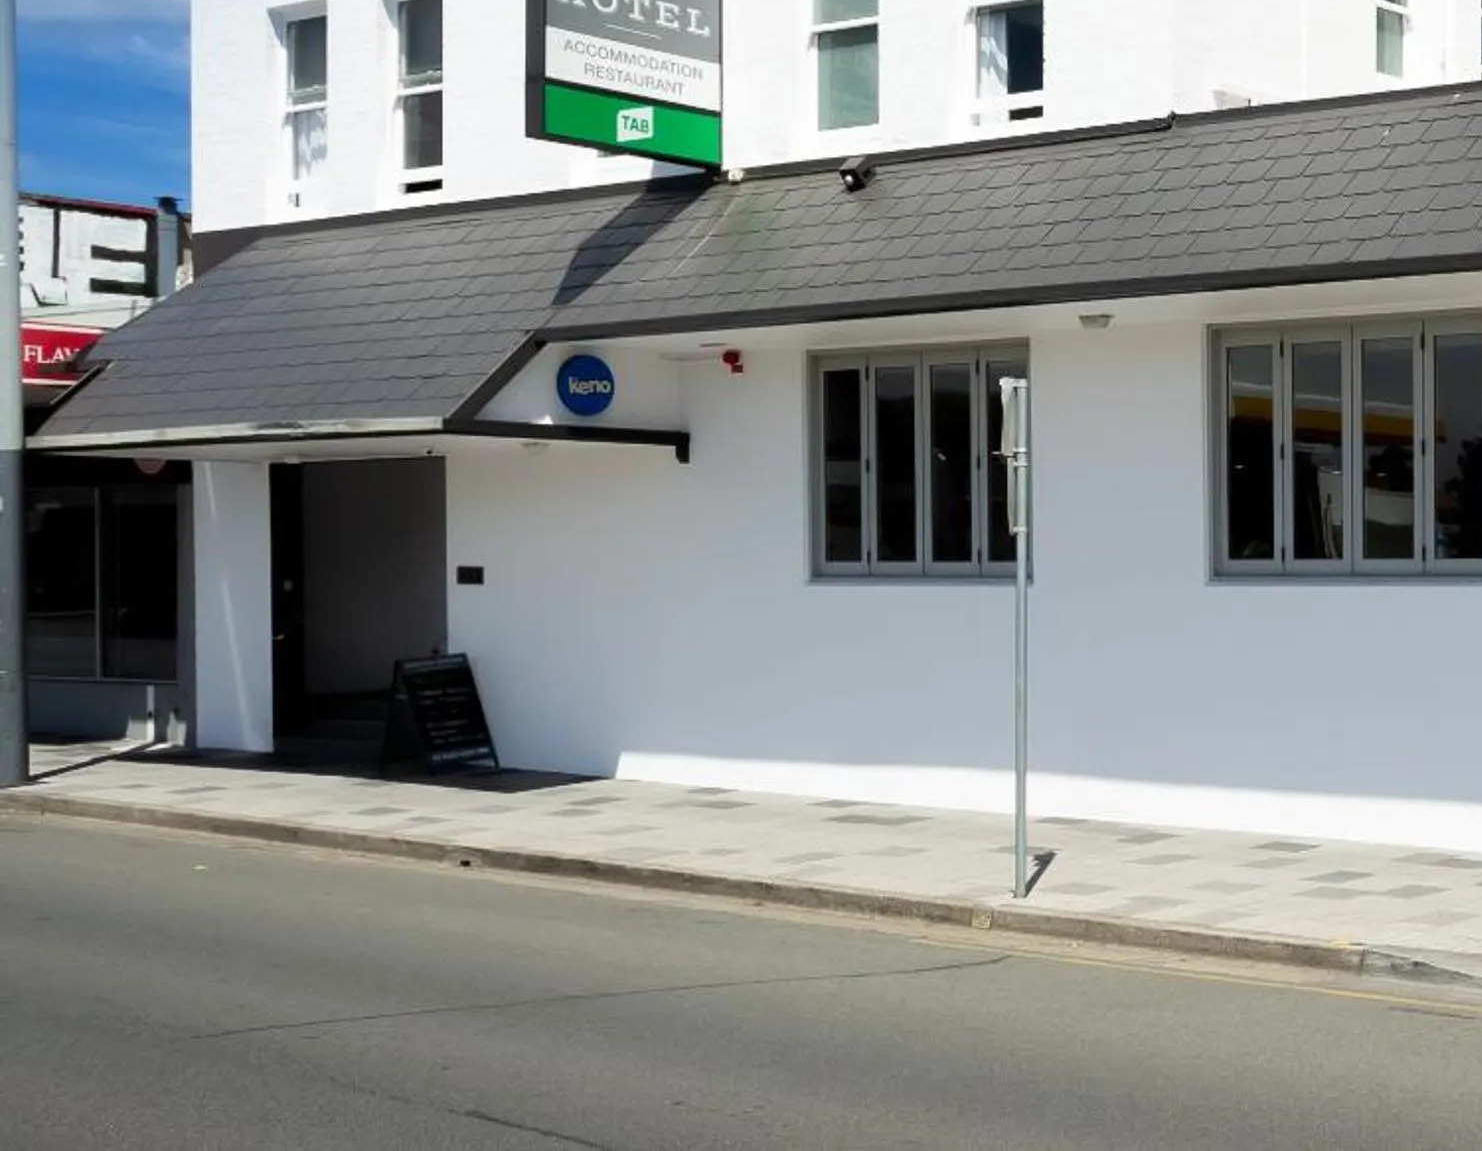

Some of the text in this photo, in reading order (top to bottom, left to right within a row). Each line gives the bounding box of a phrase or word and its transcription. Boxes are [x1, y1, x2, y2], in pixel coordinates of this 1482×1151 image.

[563, 39, 703, 80] ACCOMMODATION
[584, 63, 685, 96] RESTAURANT
[621, 115, 649, 134] TAB
[568, 376, 612, 395] keno
